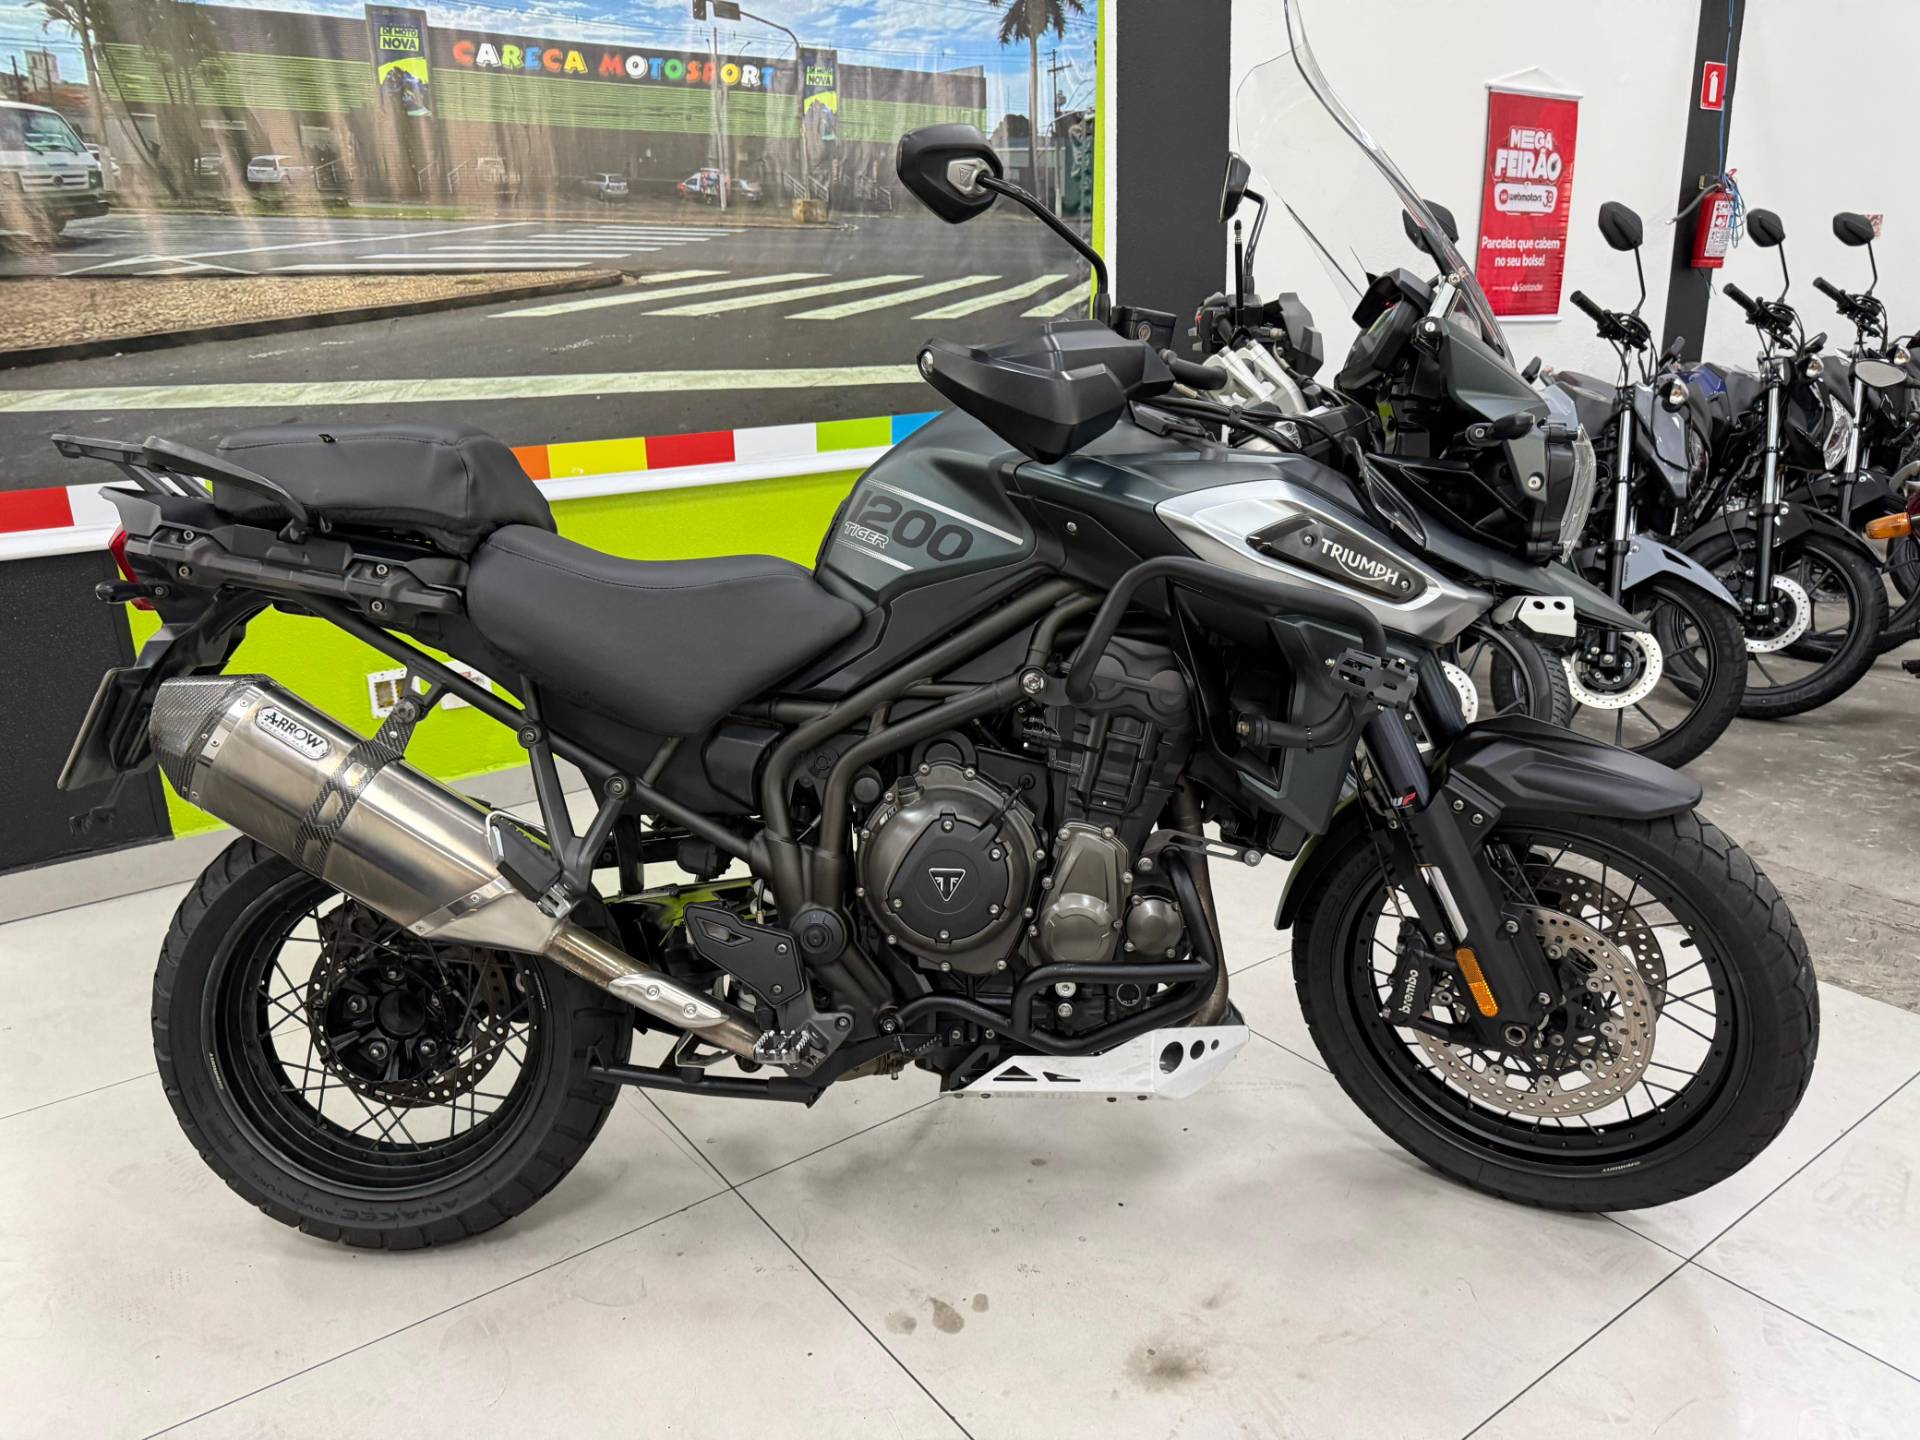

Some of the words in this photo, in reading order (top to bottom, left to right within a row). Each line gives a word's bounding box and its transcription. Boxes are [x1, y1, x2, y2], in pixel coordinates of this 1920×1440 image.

[382, 37, 417, 49] NOVA
[453, 40, 588, 74] CARECA
[598, 53, 777, 91] MOTOSPORT
[1510, 128, 1553, 151] MEGA
[1494, 147, 1562, 181] FEIRÃO
[1481, 236, 1517, 249] Parcelas
[1517, 239, 1534, 252] que
[1534, 237, 1560, 249] cabem
[1494, 257, 1506, 267] no
[1507, 256, 1521, 267] seu
[1522, 254, 1546, 267] bolso!
[844, 521, 890, 550] TIGER
[849, 490, 974, 562] 1200
[1321, 538, 1399, 586] TRIUMPH
[263, 711, 324, 749] ARROW
[1398, 969, 1419, 1014] brembo
